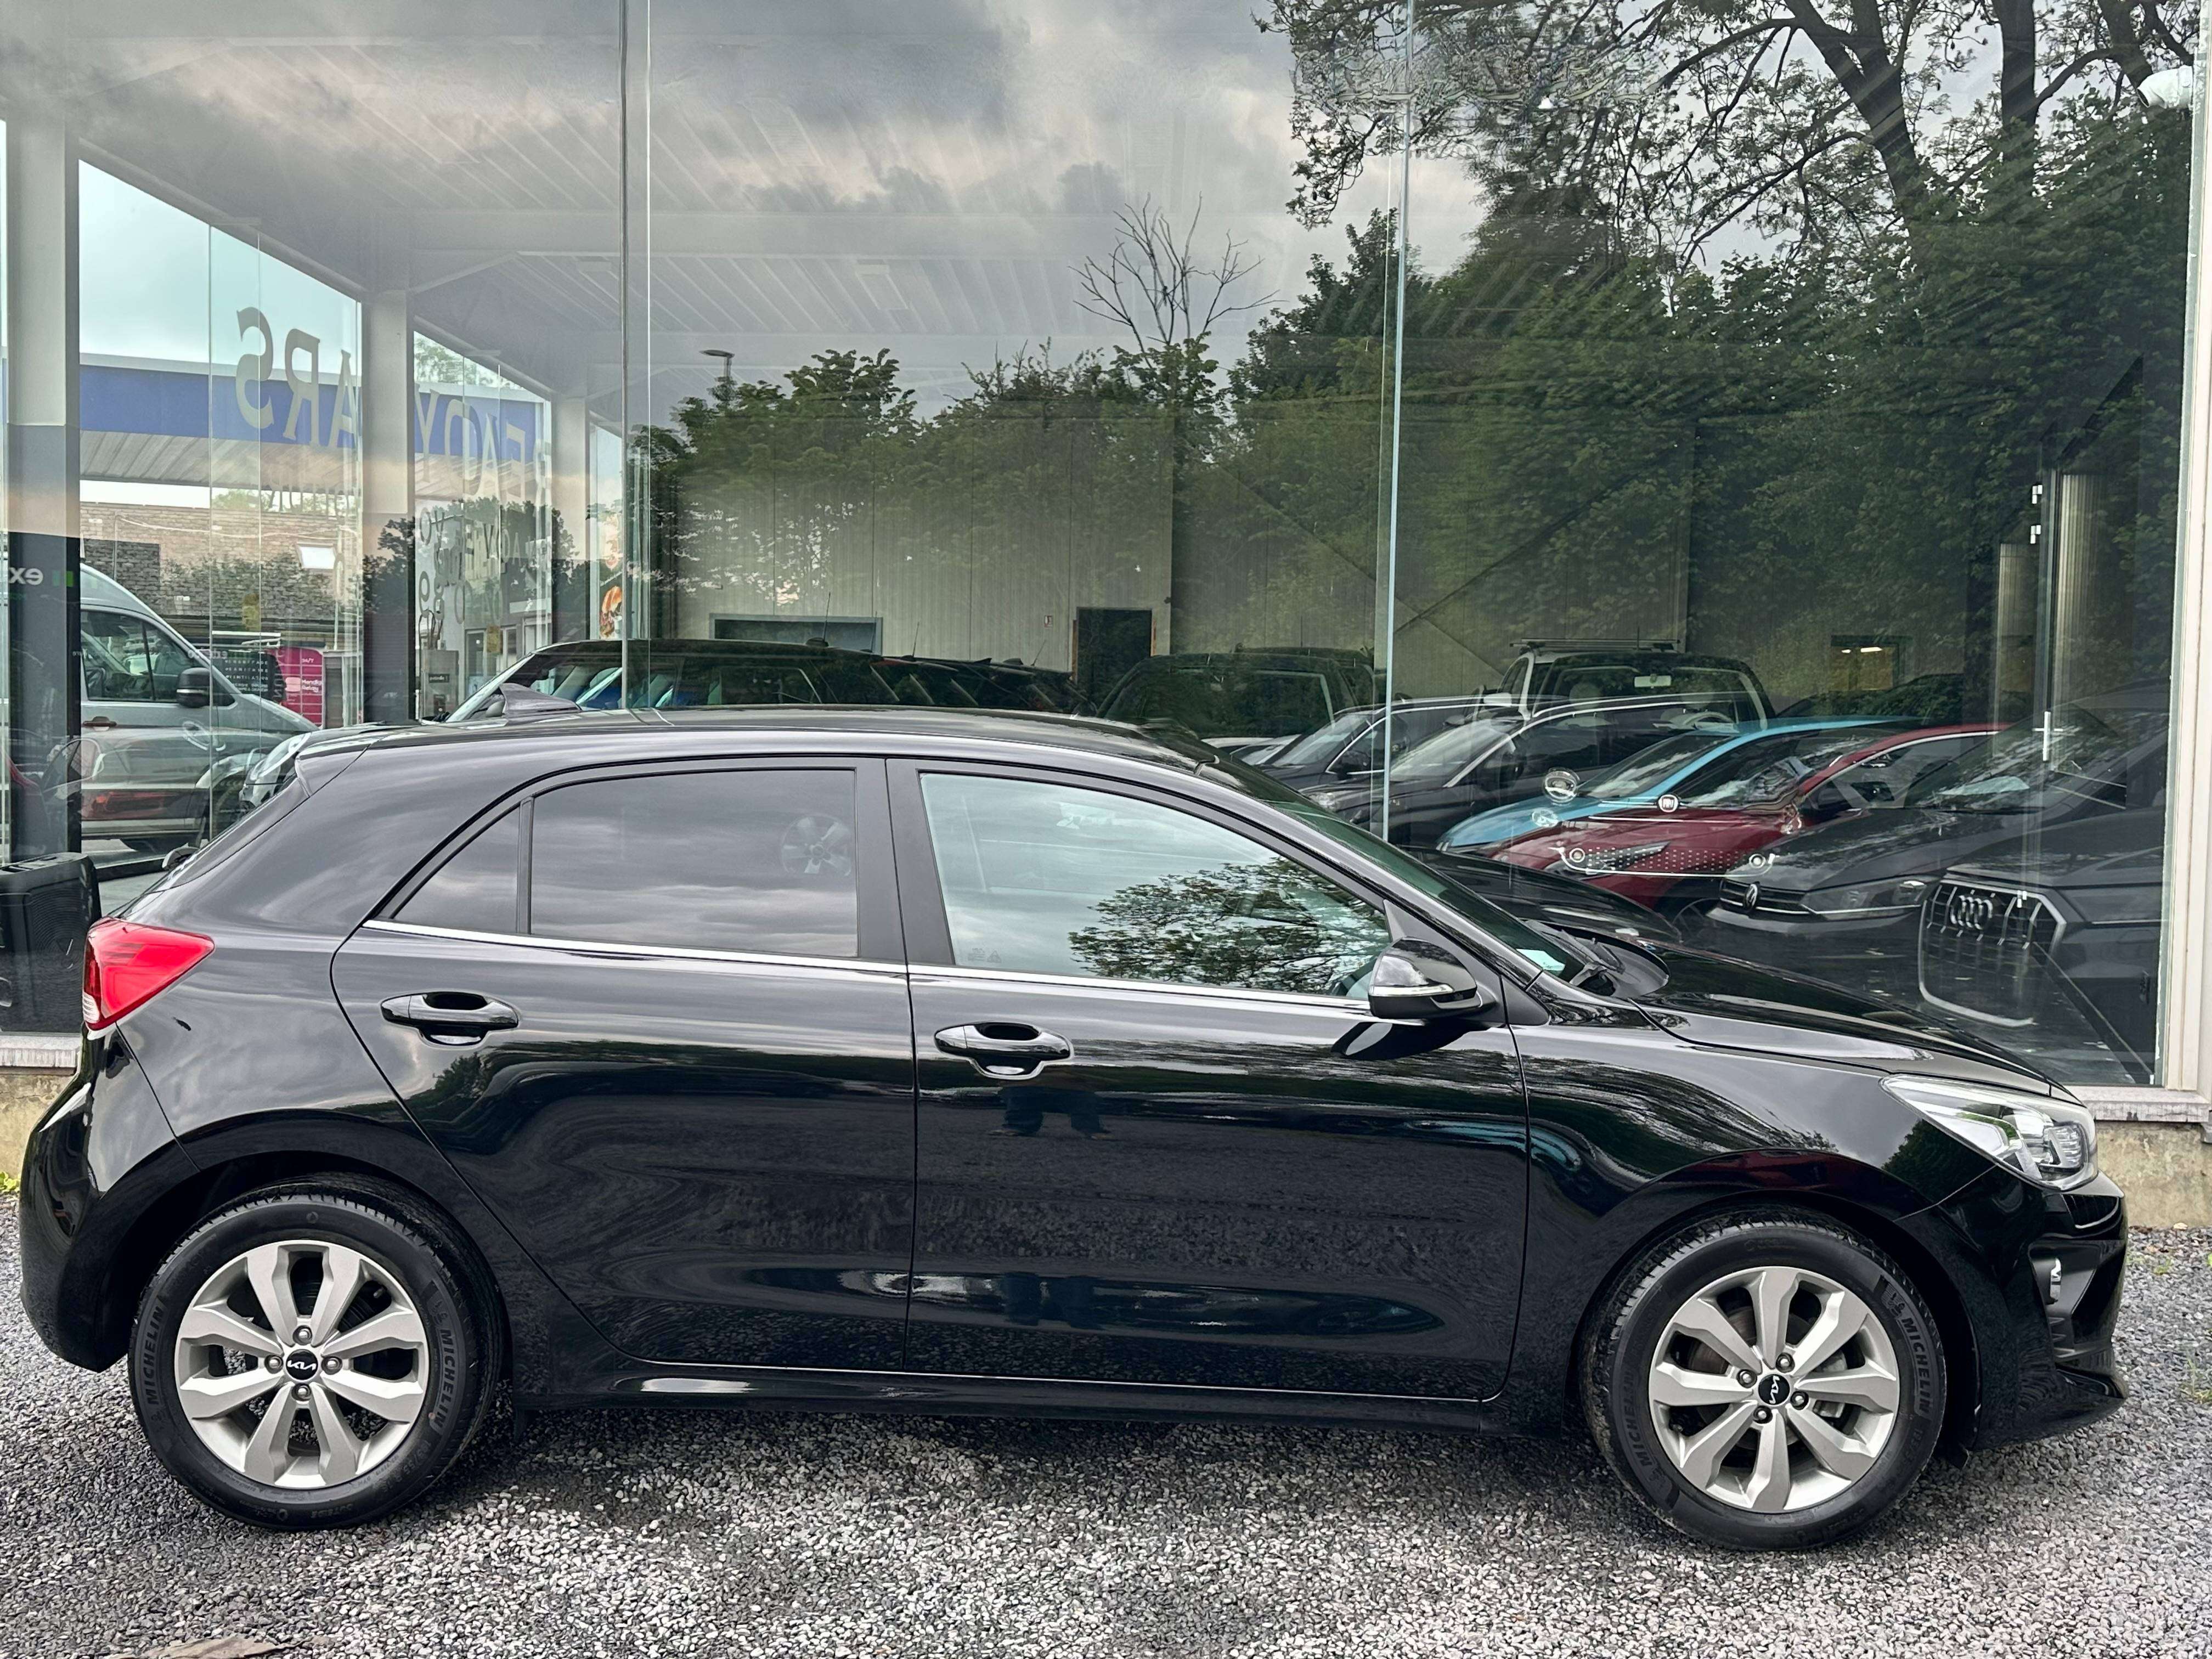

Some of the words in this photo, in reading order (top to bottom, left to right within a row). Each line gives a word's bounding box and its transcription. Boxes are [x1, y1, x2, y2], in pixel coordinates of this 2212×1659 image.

[143, 1306, 165, 1406] MICHELIN
[432, 1329, 456, 1430] MICHELIN
[1903, 1318, 1931, 1414] MICHELIN
